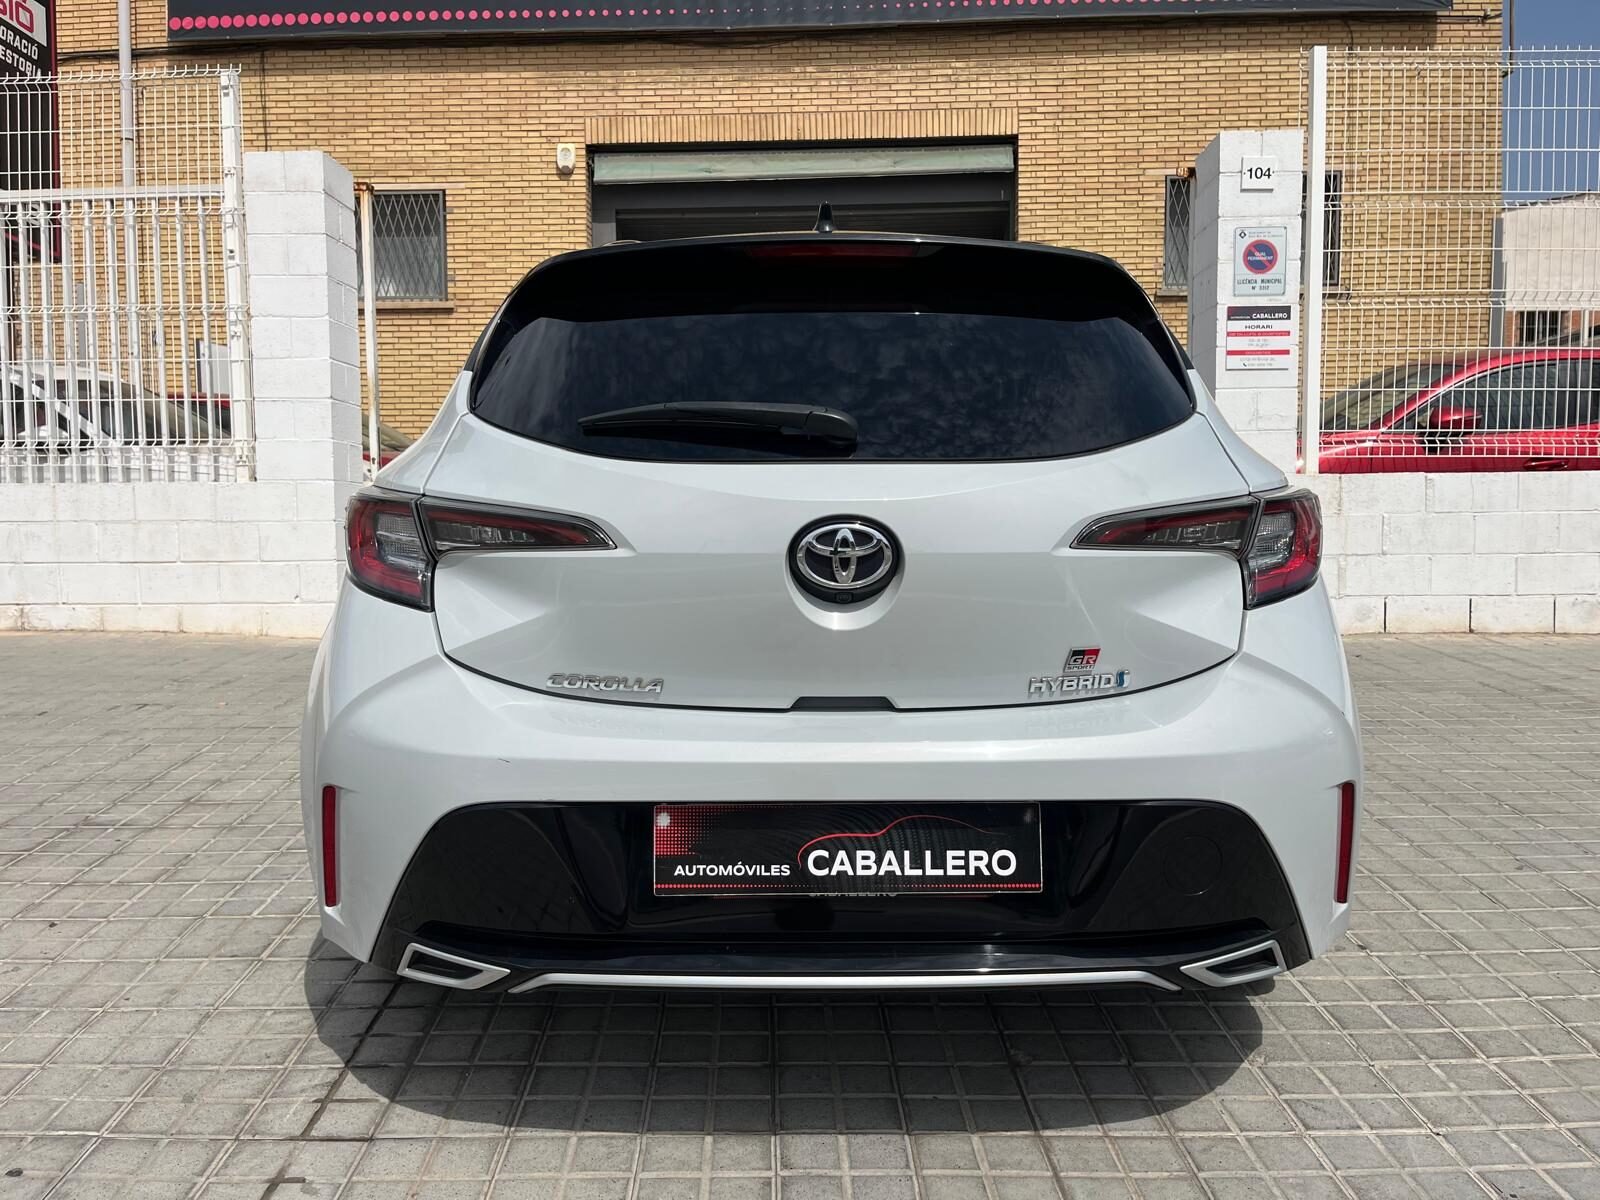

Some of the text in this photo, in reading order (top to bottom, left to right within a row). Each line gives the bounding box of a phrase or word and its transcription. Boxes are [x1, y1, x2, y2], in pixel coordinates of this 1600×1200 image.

[0, 25, 39, 60] ORACIÓ
[1246, 167, 1272, 180] 104
[1069, 655, 1097, 664] GR
[546, 673, 664, 693] COROLLA
[1030, 674, 1114, 692] HYBRID
[673, 849, 1018, 877] AUTOMÓVILES CABALLERO
